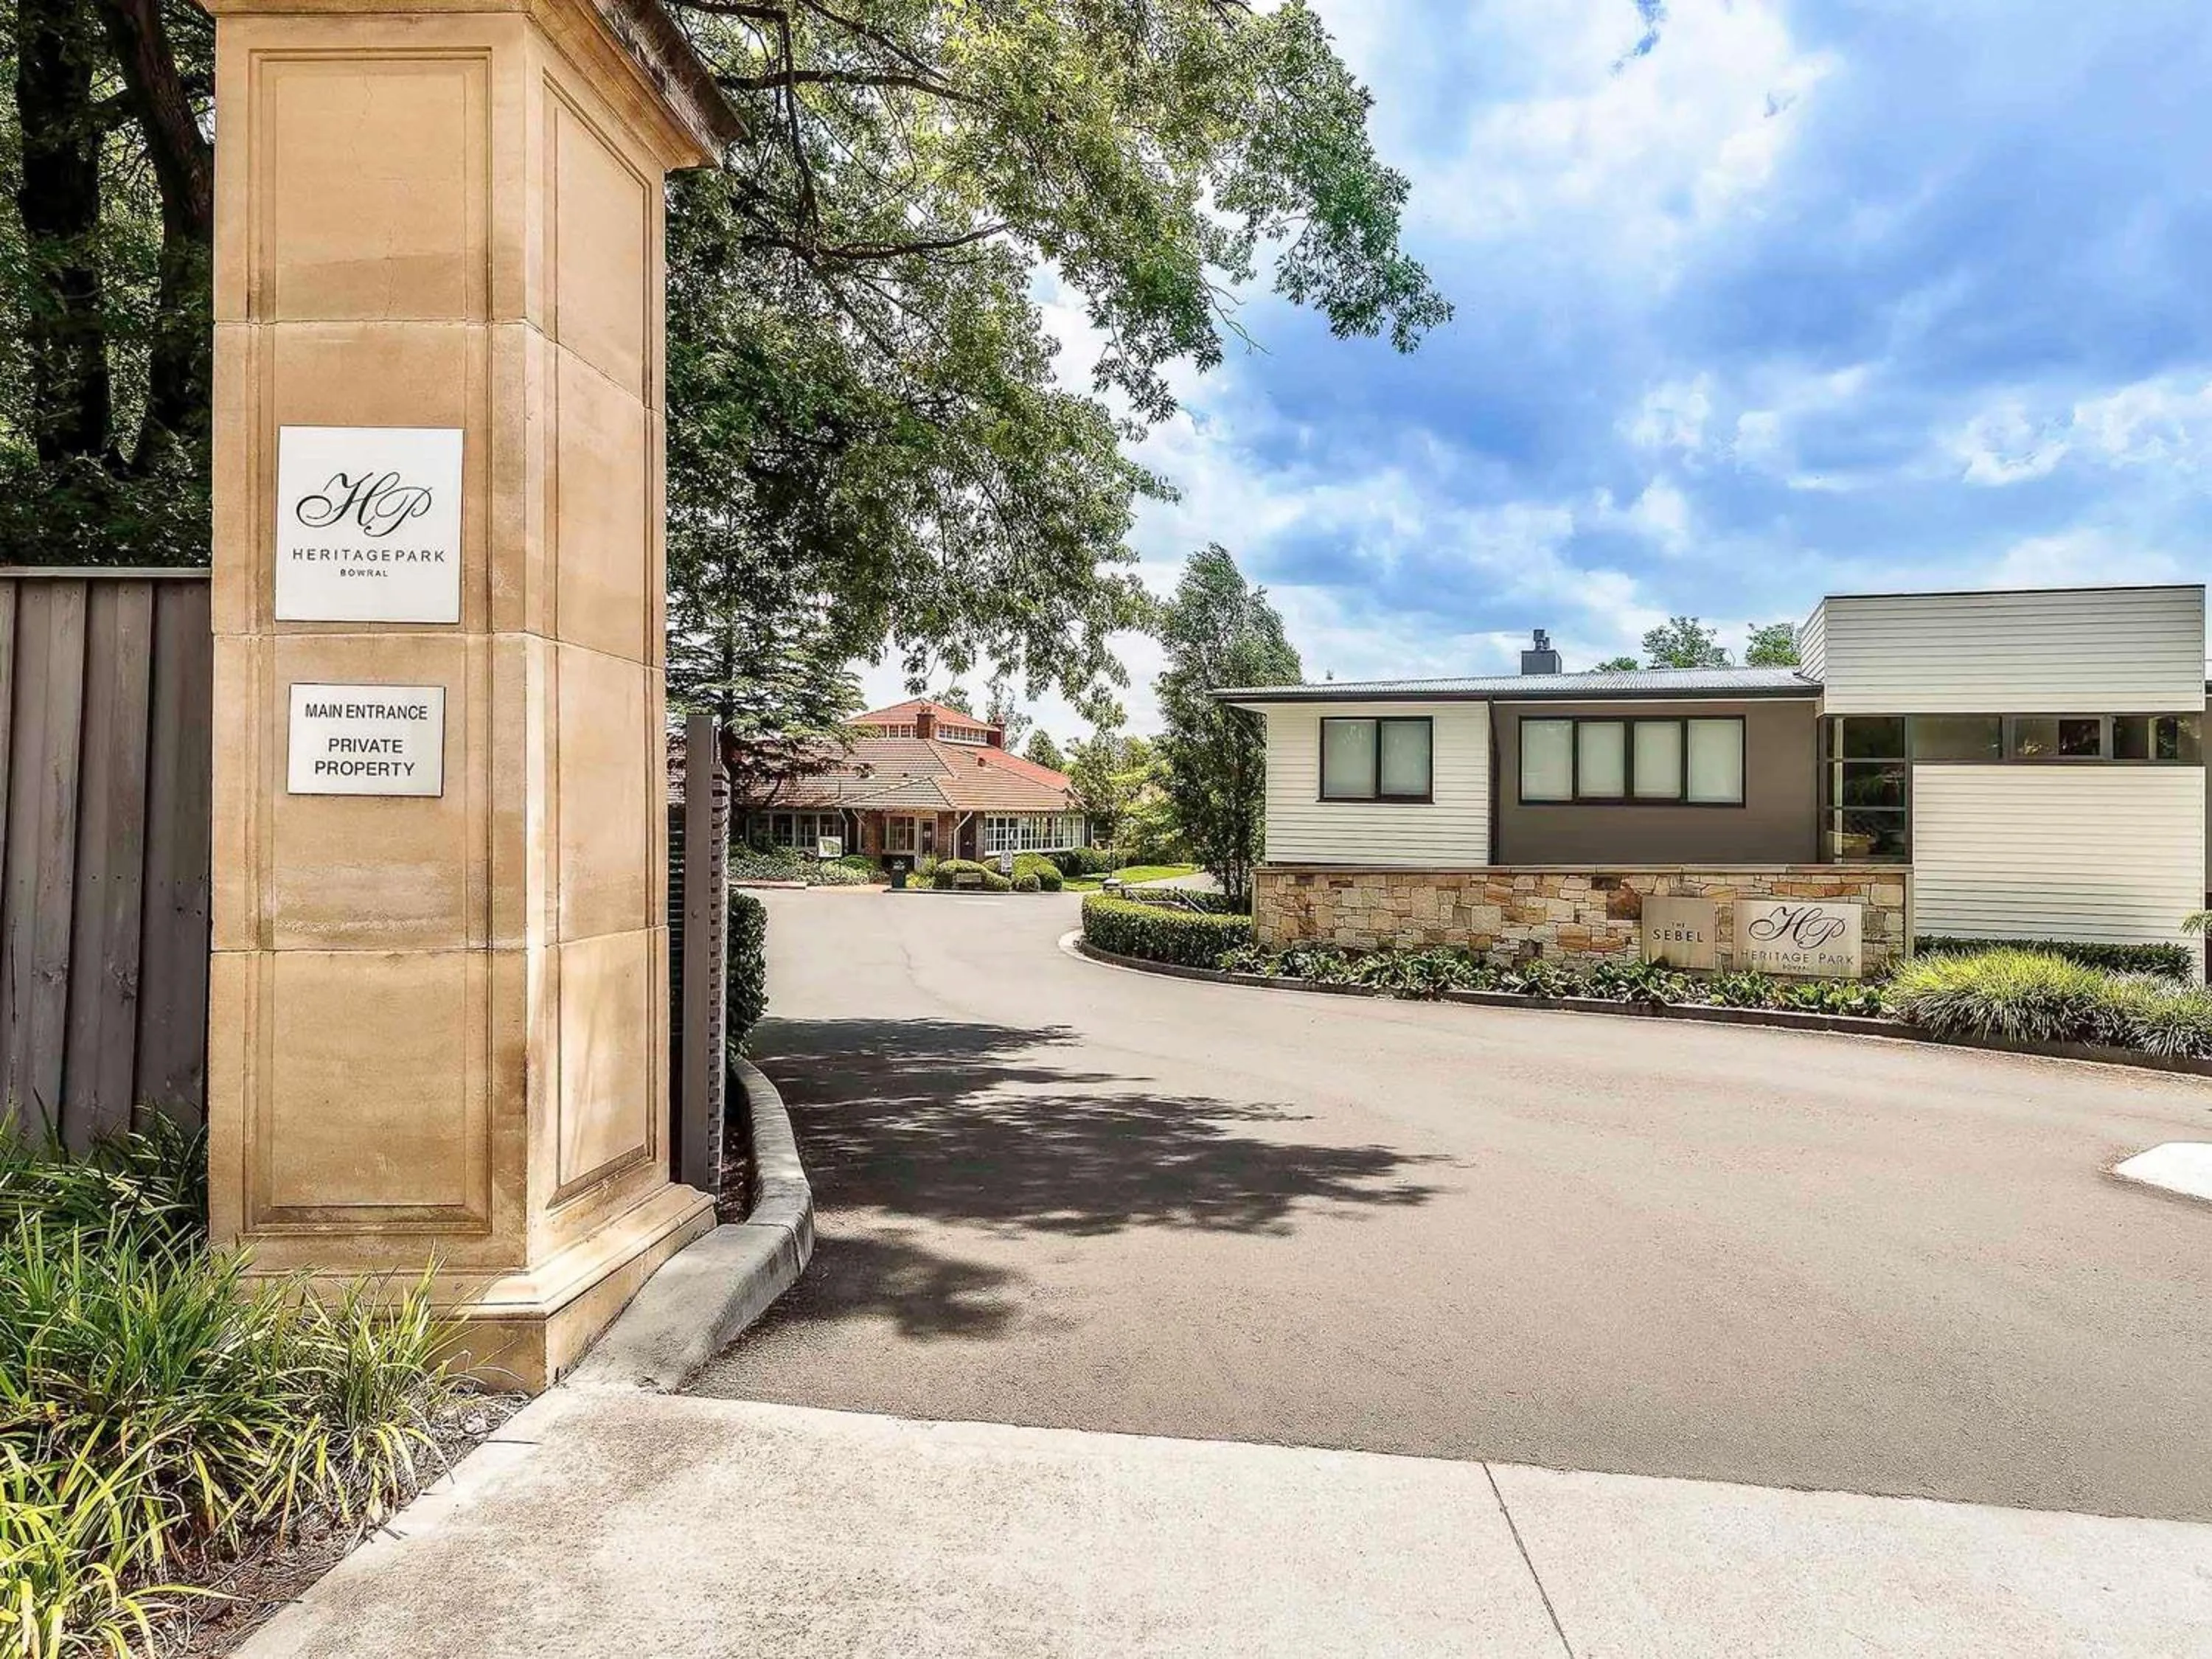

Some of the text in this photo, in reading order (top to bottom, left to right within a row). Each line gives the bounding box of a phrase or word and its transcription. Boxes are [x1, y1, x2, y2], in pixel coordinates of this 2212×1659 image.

[340, 568, 389, 577] BOWRAL
[305, 703, 428, 720] MAIN ENTRANCE
[328, 738, 404, 754] PRIVATE
[315, 761, 415, 776] PROPERTY
[1652, 928, 1704, 942] SEBEL
[1740, 950, 1854, 964] HERITAGE PARK
